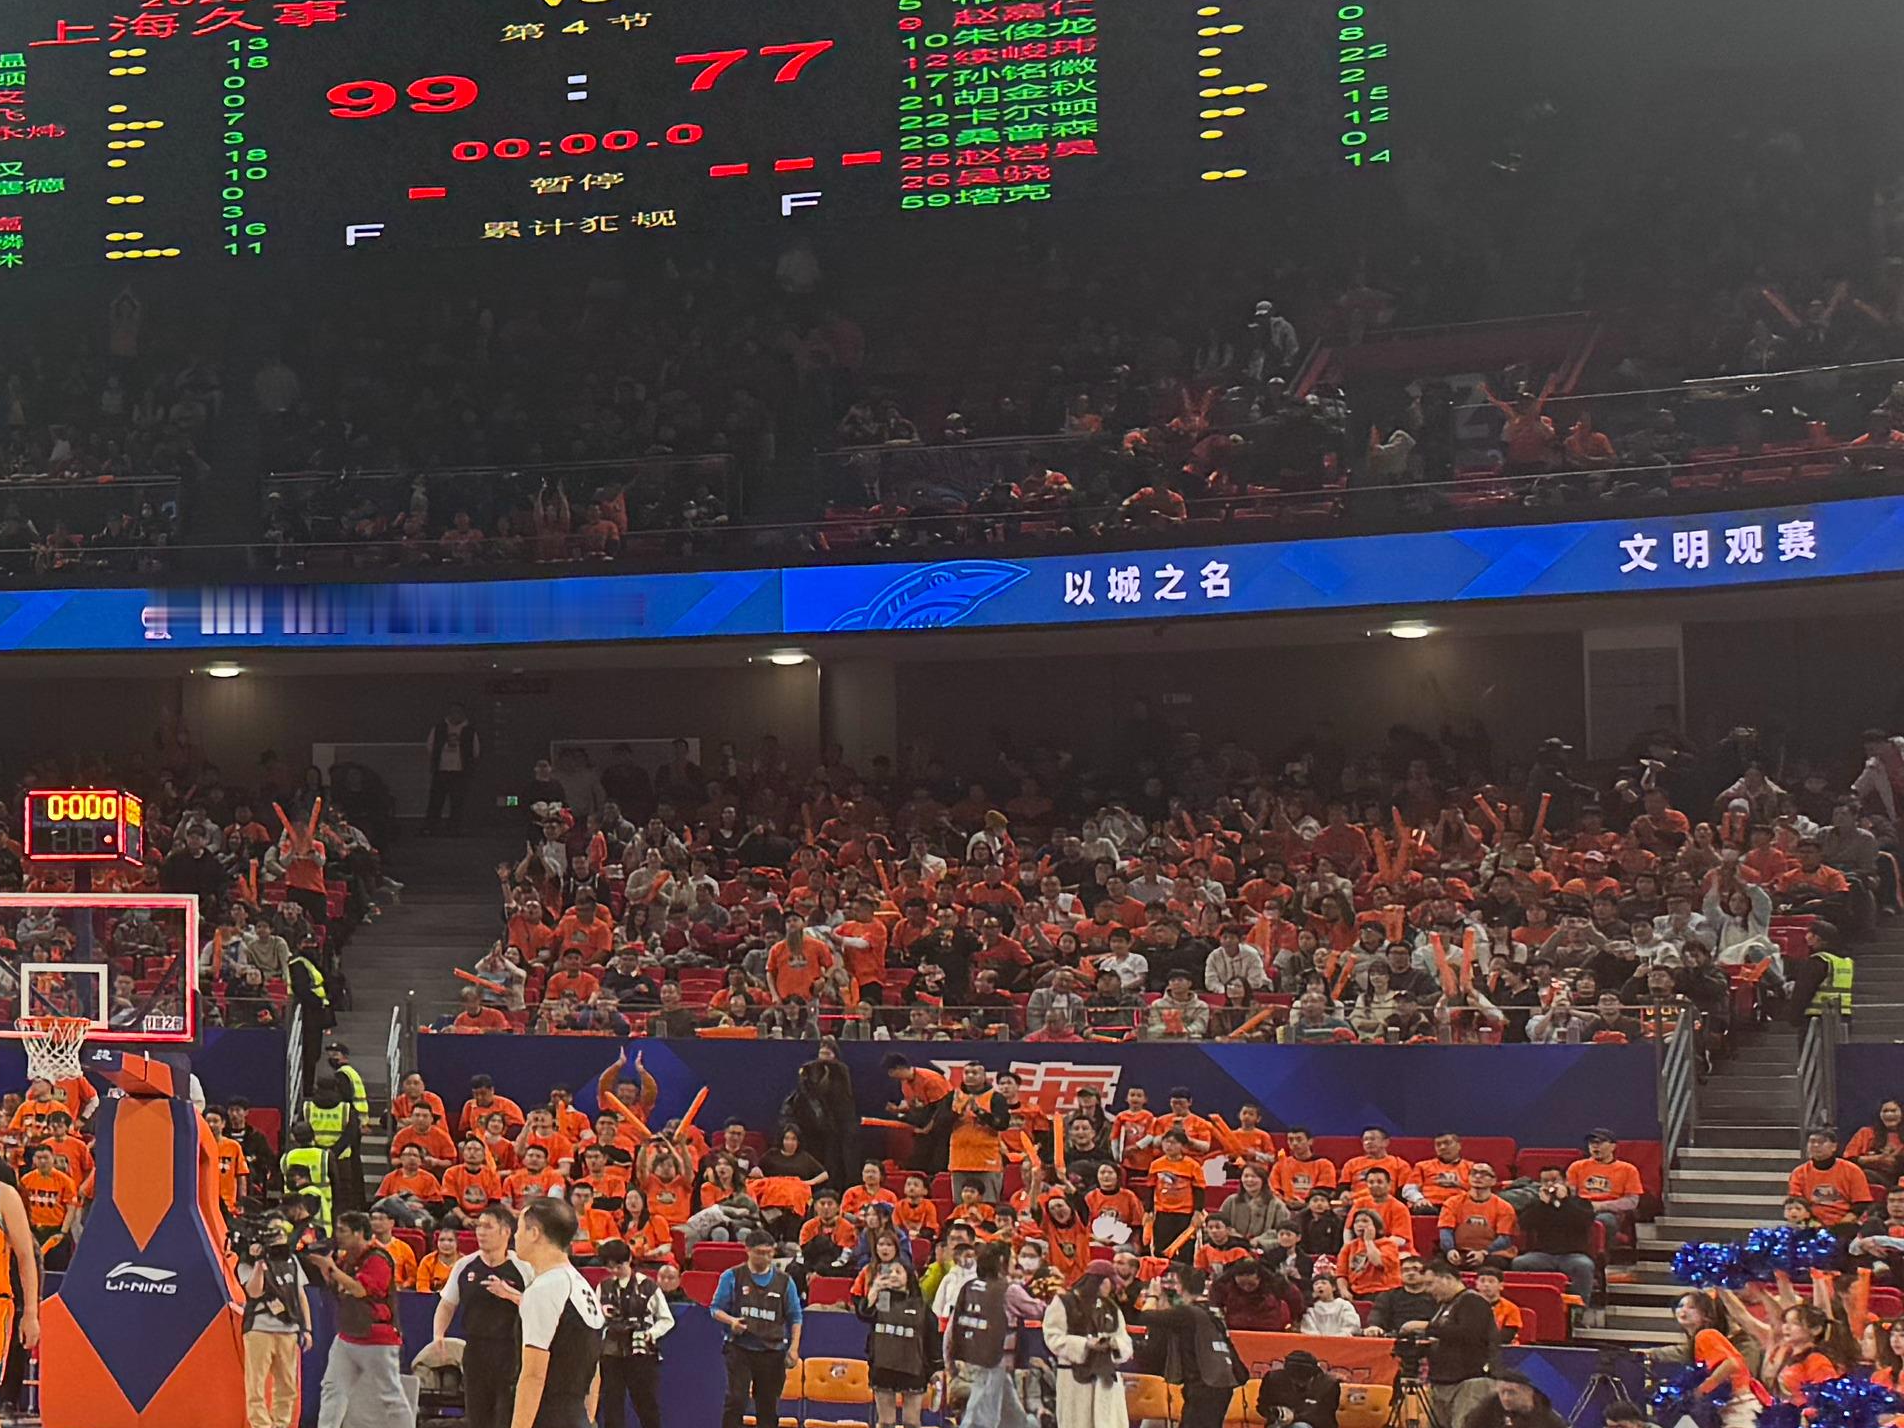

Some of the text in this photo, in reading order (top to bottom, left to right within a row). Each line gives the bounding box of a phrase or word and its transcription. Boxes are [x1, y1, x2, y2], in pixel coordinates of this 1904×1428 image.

[898, 17, 922, 30] 9
[902, 34, 949, 50] 10
[953, 18, 1096, 45] 朱俊龙
[226, 38, 269, 51] 13
[902, 54, 949, 71] 12
[1338, 6, 1364, 20] 0
[226, 56, 269, 70] 18
[902, 73, 949, 90] 17
[1339, 27, 1364, 40] 8
[224, 75, 245, 89] 0
[326, 75, 479, 118] 99
[674, 40, 834, 92] 77
[899, 43, 1387, 110] 21 胡金秋 22
[224, 94, 245, 108] 0
[899, 68, 1365, 130] 22 卡尔顿 2
[224, 112, 245, 126] 7
[900, 133, 949, 150] 23
[1344, 85, 1388, 103] 15
[223, 131, 245, 145] 3
[452, 123, 703, 161] 00:00.0
[901, 153, 950, 170] 25
[1344, 107, 1389, 124] 12
[225, 148, 268, 163] 18
[901, 173, 950, 190] 26
[1342, 131, 1367, 145] 0
[225, 167, 268, 181] 10
[529, 172, 624, 195] 暂停
[901, 150, 1390, 209] 59 塔克 14
[222, 186, 244, 200] 0
[781, 190, 822, 216] F
[222, 206, 244, 219] 3
[479, 208, 677, 240] 累计犯规
[225, 223, 268, 237] 16
[345, 223, 384, 247] F
[224, 241, 263, 255] 11
[1619, 521, 1819, 573] 文明观赛
[1062, 561, 1233, 608] 以城之名
[105, 1280, 177, 1294] LI-NING
